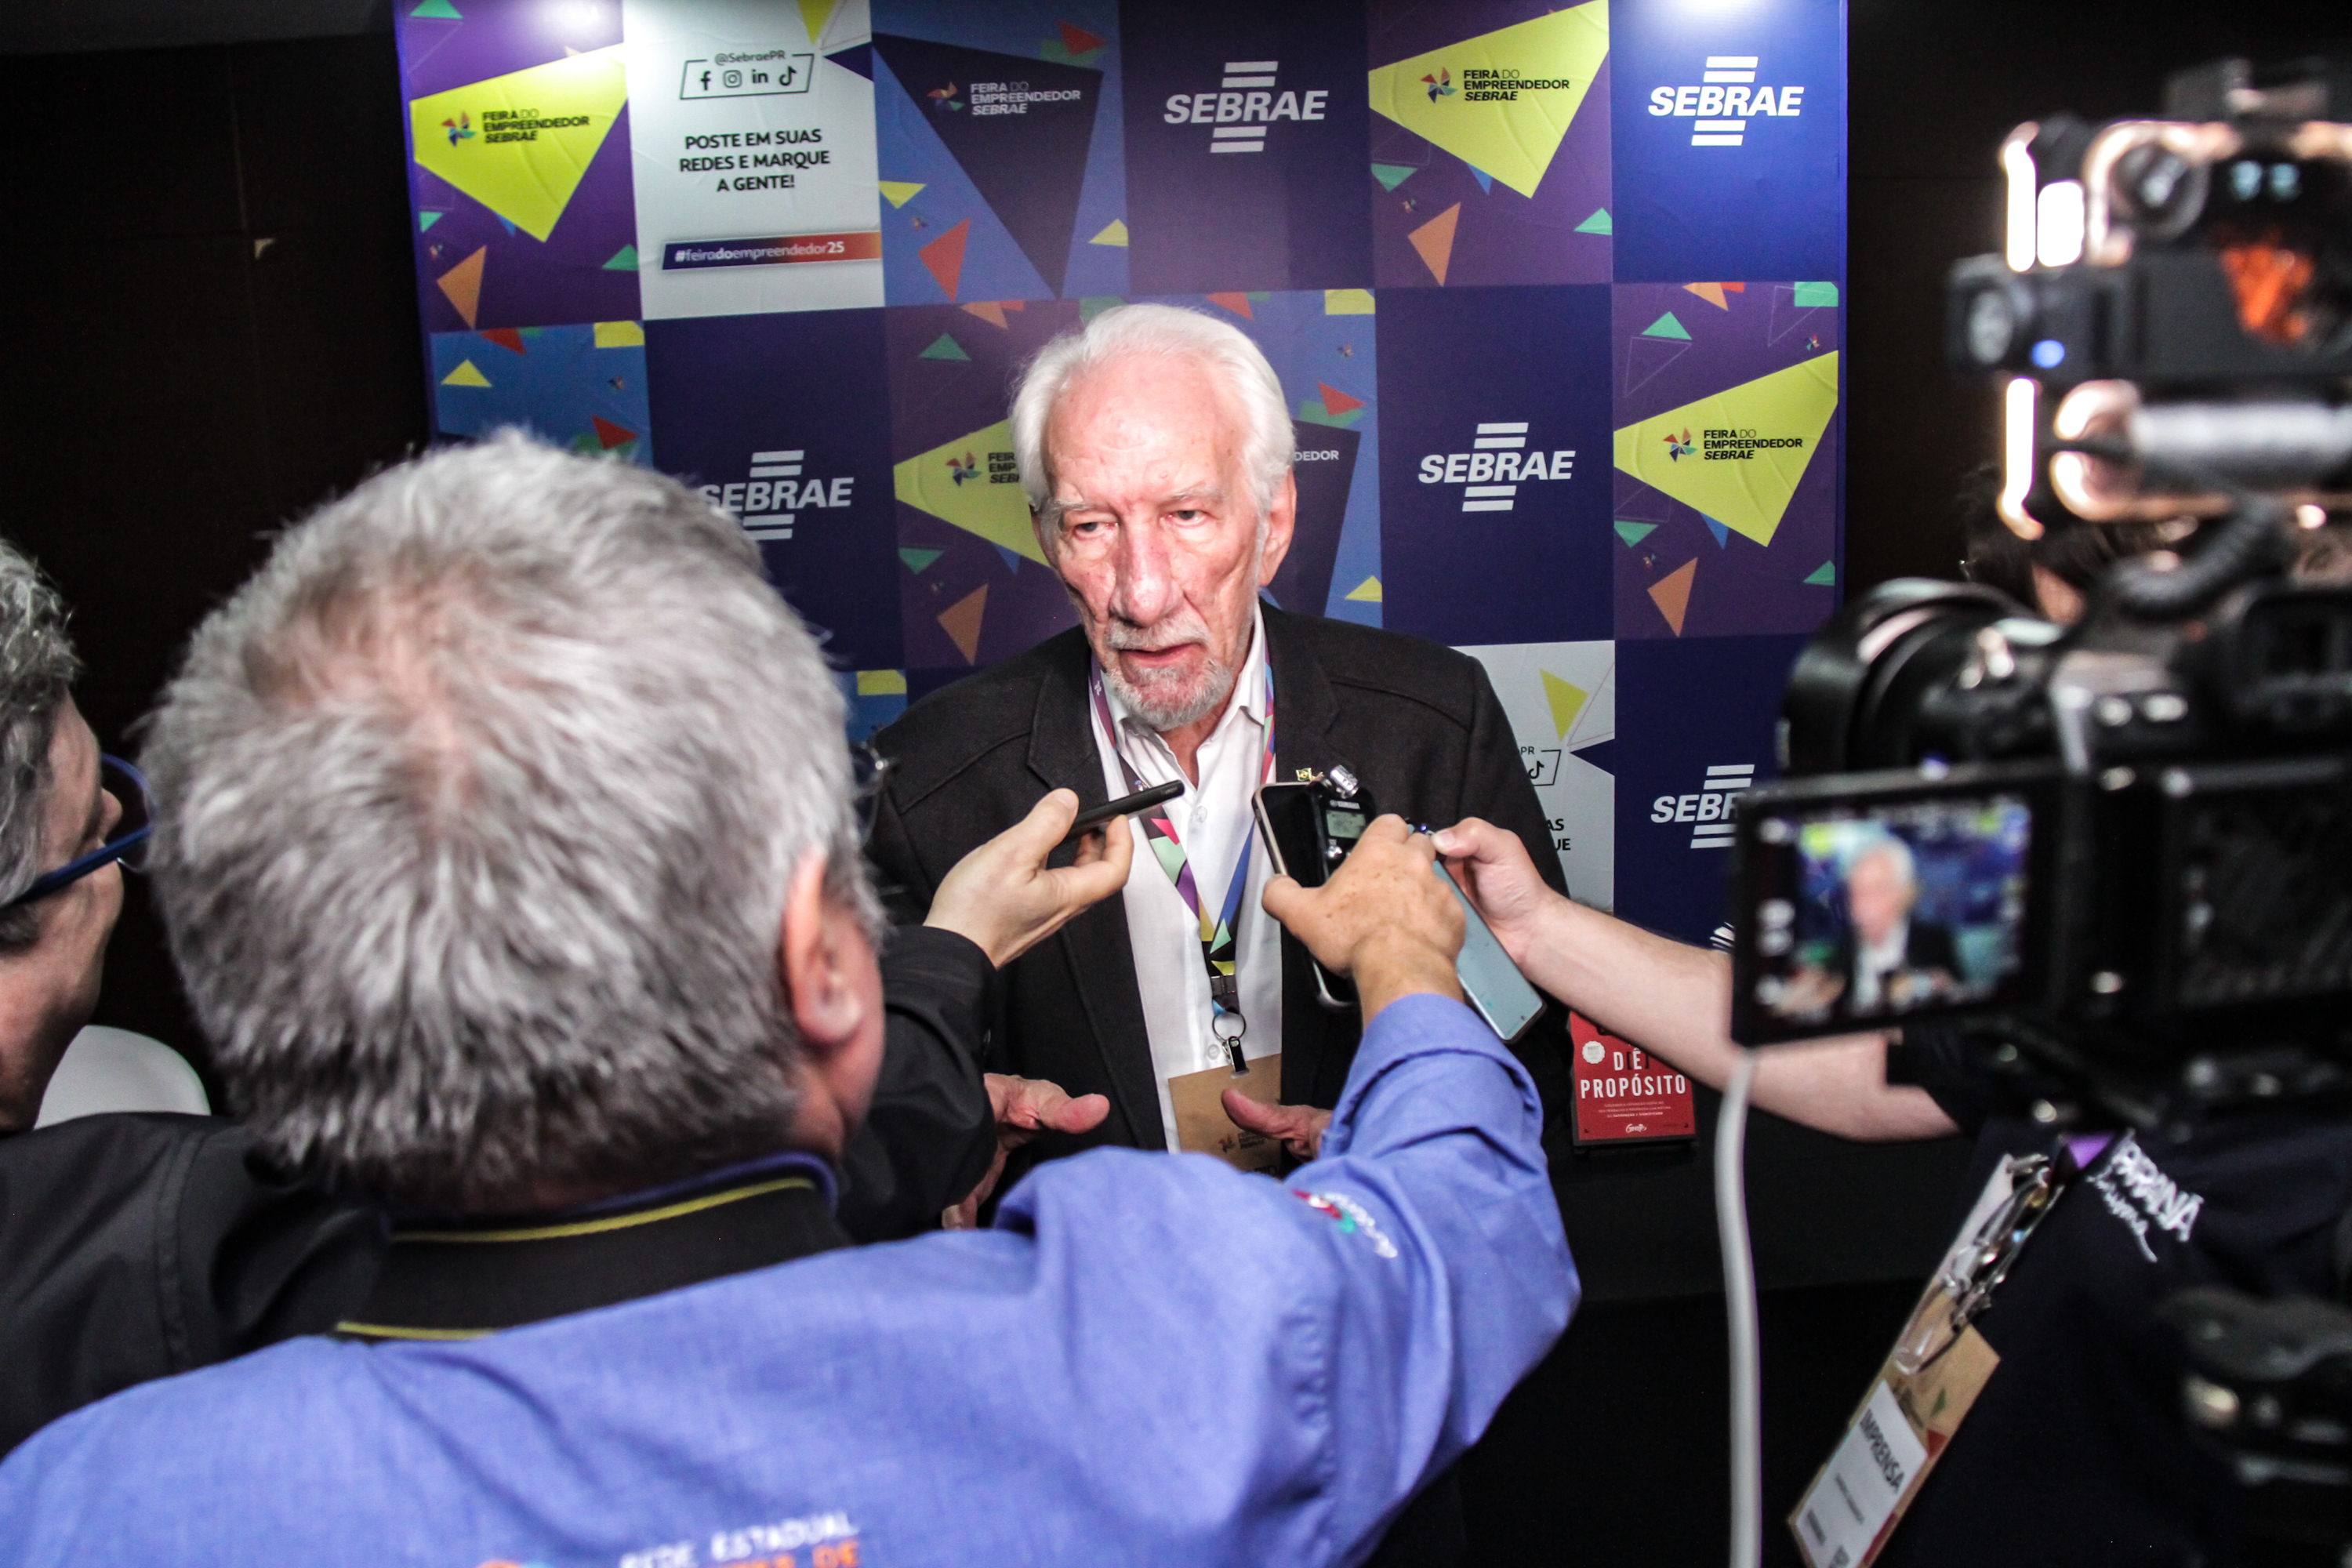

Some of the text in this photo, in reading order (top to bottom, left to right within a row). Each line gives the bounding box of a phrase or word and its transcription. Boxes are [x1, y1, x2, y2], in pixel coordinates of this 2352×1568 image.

[714, 49, 786, 66] @SebraePR
[1464, 69, 1520, 79] FEIRA DO
[971, 81, 1029, 93] FEIRA DO
[1464, 79, 1570, 90] EMPREENDEDOR
[971, 90, 1081, 104] EMPREENDEDOR
[1465, 91, 1518, 101] SEBRAE
[1648, 85, 1805, 117] SEBRAE
[482, 108, 539, 121] FEIRA DO
[972, 103, 1028, 115] SEBRAE
[1163, 90, 1329, 124] SEBRAE
[483, 115, 590, 132] EMPREENDEDOR
[485, 130, 538, 143] SEBRAE
[685, 129, 822, 149] POSTE EM SUAS
[680, 151, 830, 172] REDES E MARQUE
[717, 174, 795, 192] A GENTE!
[674, 241, 845, 263] #feiradoempreendedor25
[1704, 429, 1756, 439] FEIRA DO
[1704, 438, 1803, 449] EMPREENDEDOR
[988, 452, 1015, 462] FEIR
[1704, 450, 1755, 460] SEBRAE
[1418, 450, 1576, 485] SEBRAE
[1650, 793, 1747, 823] SEBR
[1581, 1073, 1686, 1098] PROPÓSITO
[1859, 1408, 1905, 1494] IMPRENSA
[711, 1512, 858, 1562] ESTADUAL
